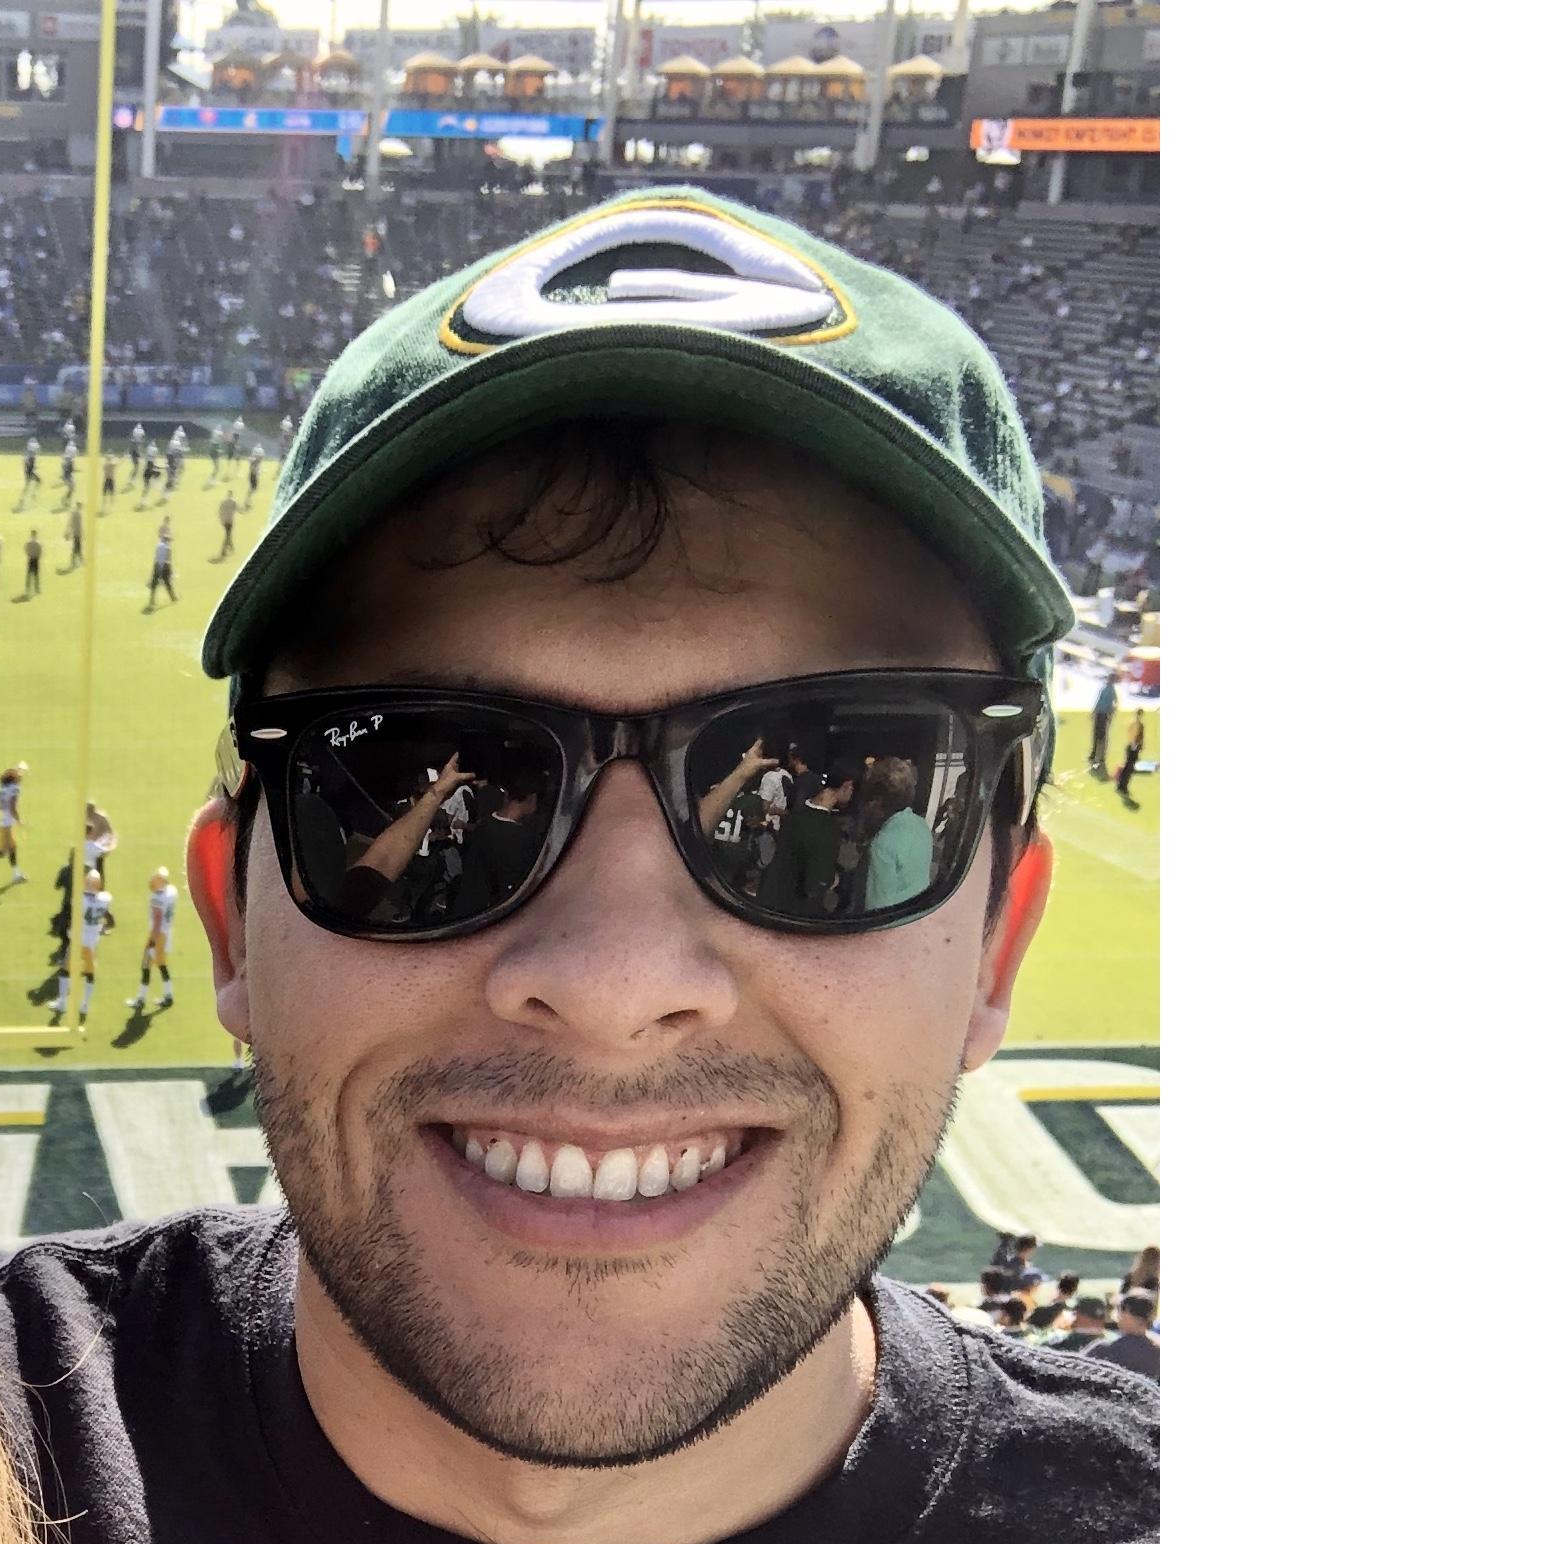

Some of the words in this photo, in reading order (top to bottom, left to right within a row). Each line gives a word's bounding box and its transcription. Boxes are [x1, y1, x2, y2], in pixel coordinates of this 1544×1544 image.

[463, 210, 834, 337] G
[323, 720, 369, 747] Ray-Ban
[370, 714, 384, 731] P
